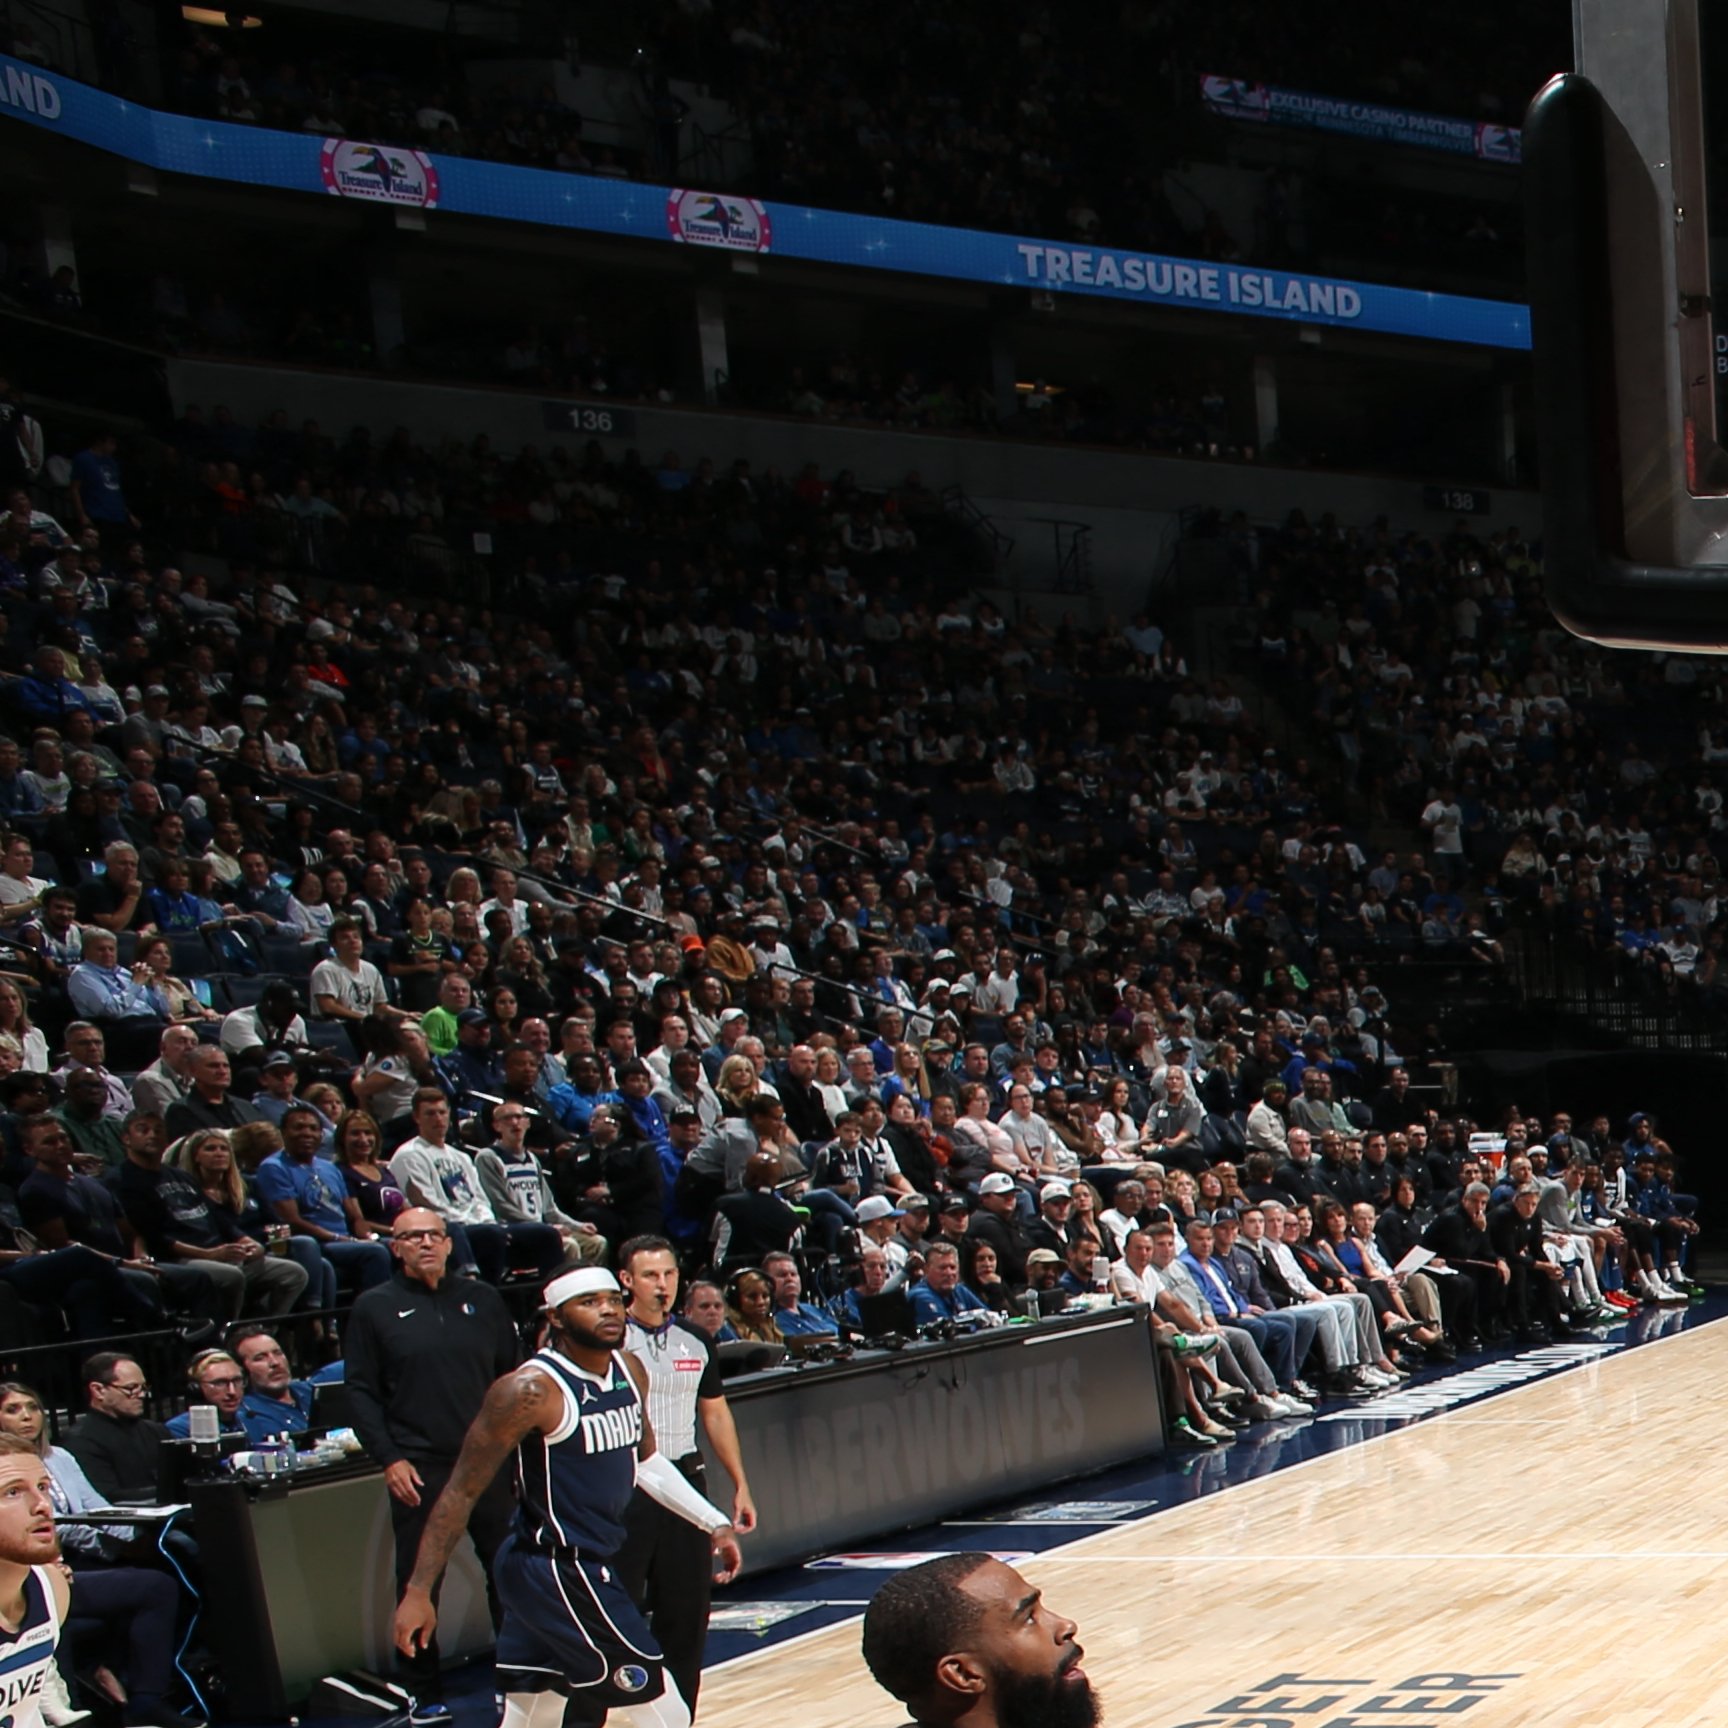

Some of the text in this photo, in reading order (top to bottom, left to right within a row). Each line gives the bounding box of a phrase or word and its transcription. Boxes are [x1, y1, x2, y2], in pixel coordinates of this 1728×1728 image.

[1269, 91, 1348, 118] EXCLUSIVE
[1351, 105, 1405, 127] CASINO
[1406, 114, 1474, 138] PARTNER
[1018, 244, 1361, 319] TREASURE ISLAND
[568, 408, 613, 432] 136
[1441, 491, 1475, 511] 138
